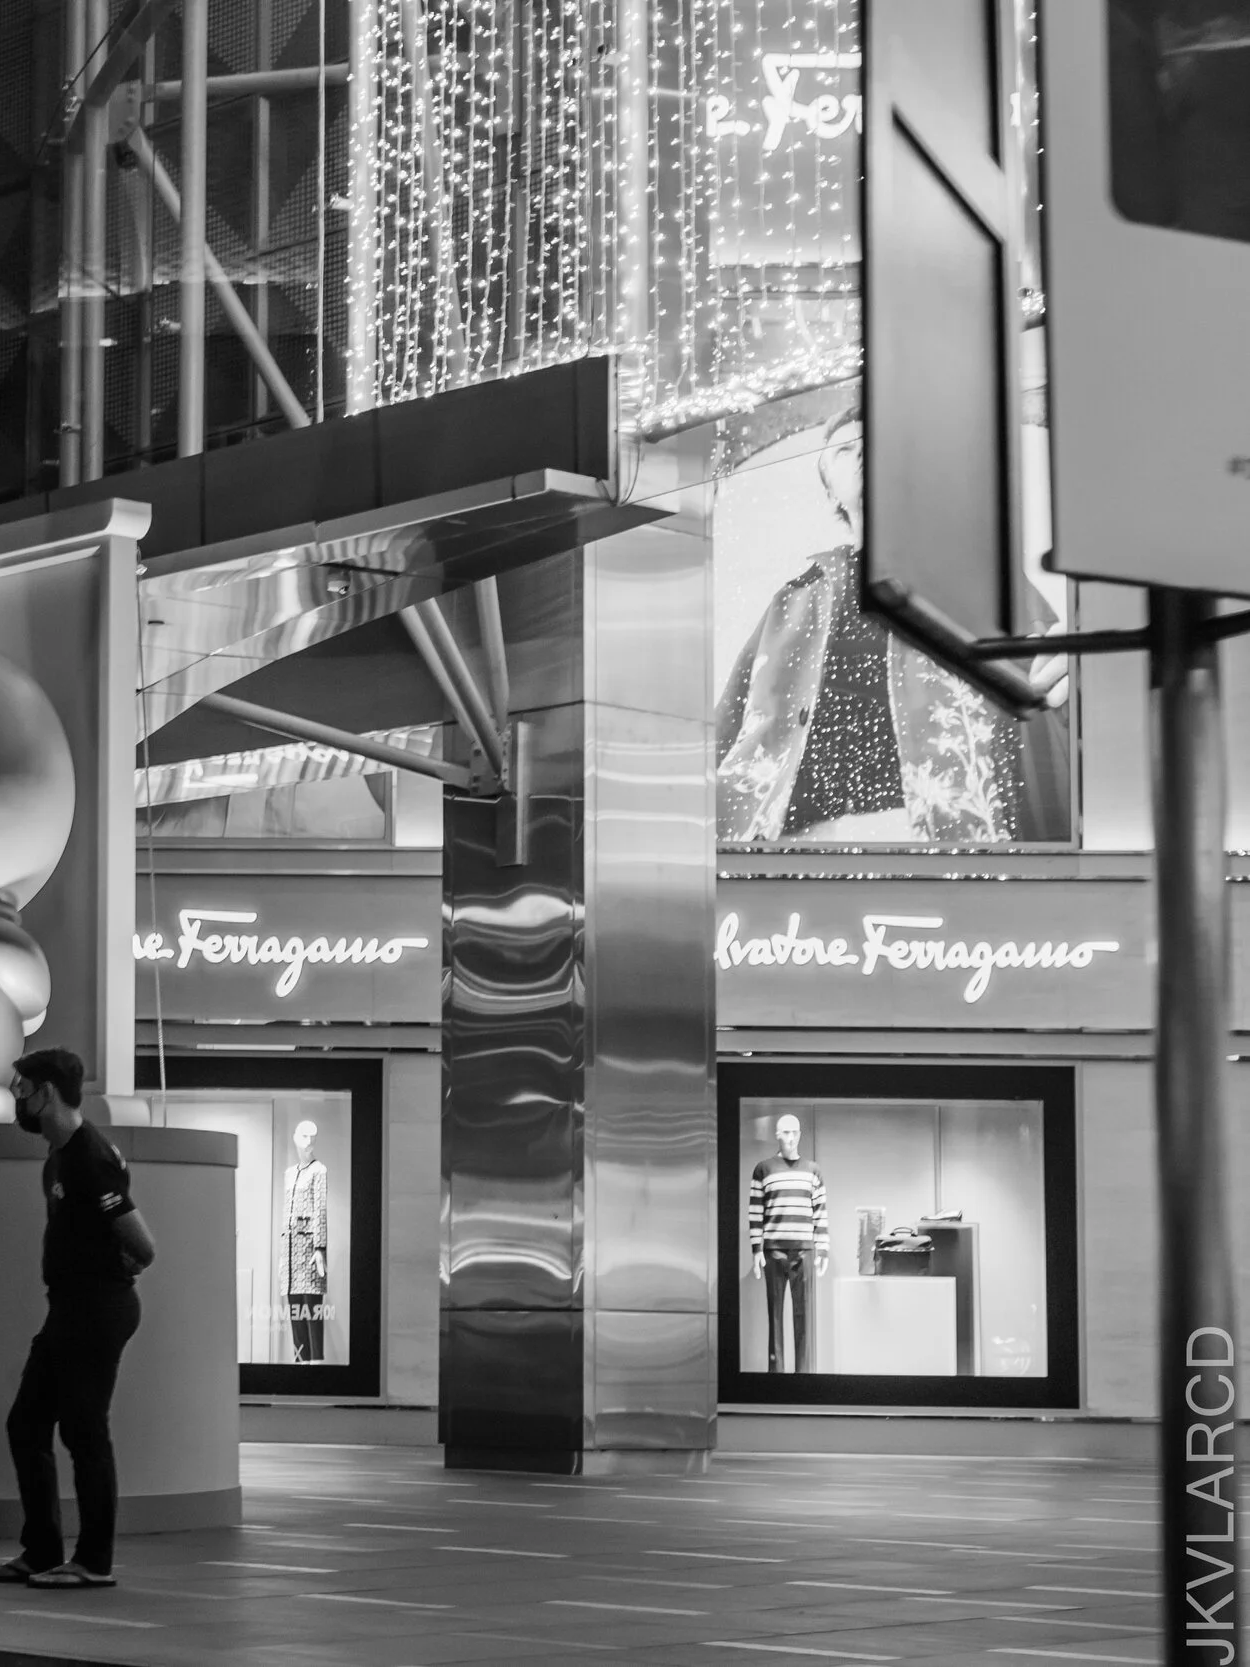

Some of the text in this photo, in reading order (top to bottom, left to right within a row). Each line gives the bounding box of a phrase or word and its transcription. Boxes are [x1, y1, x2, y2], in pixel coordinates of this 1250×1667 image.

[176, 908, 429, 998] Ferragamo
[713, 911, 1120, 1003] lvatore Ferragamo
